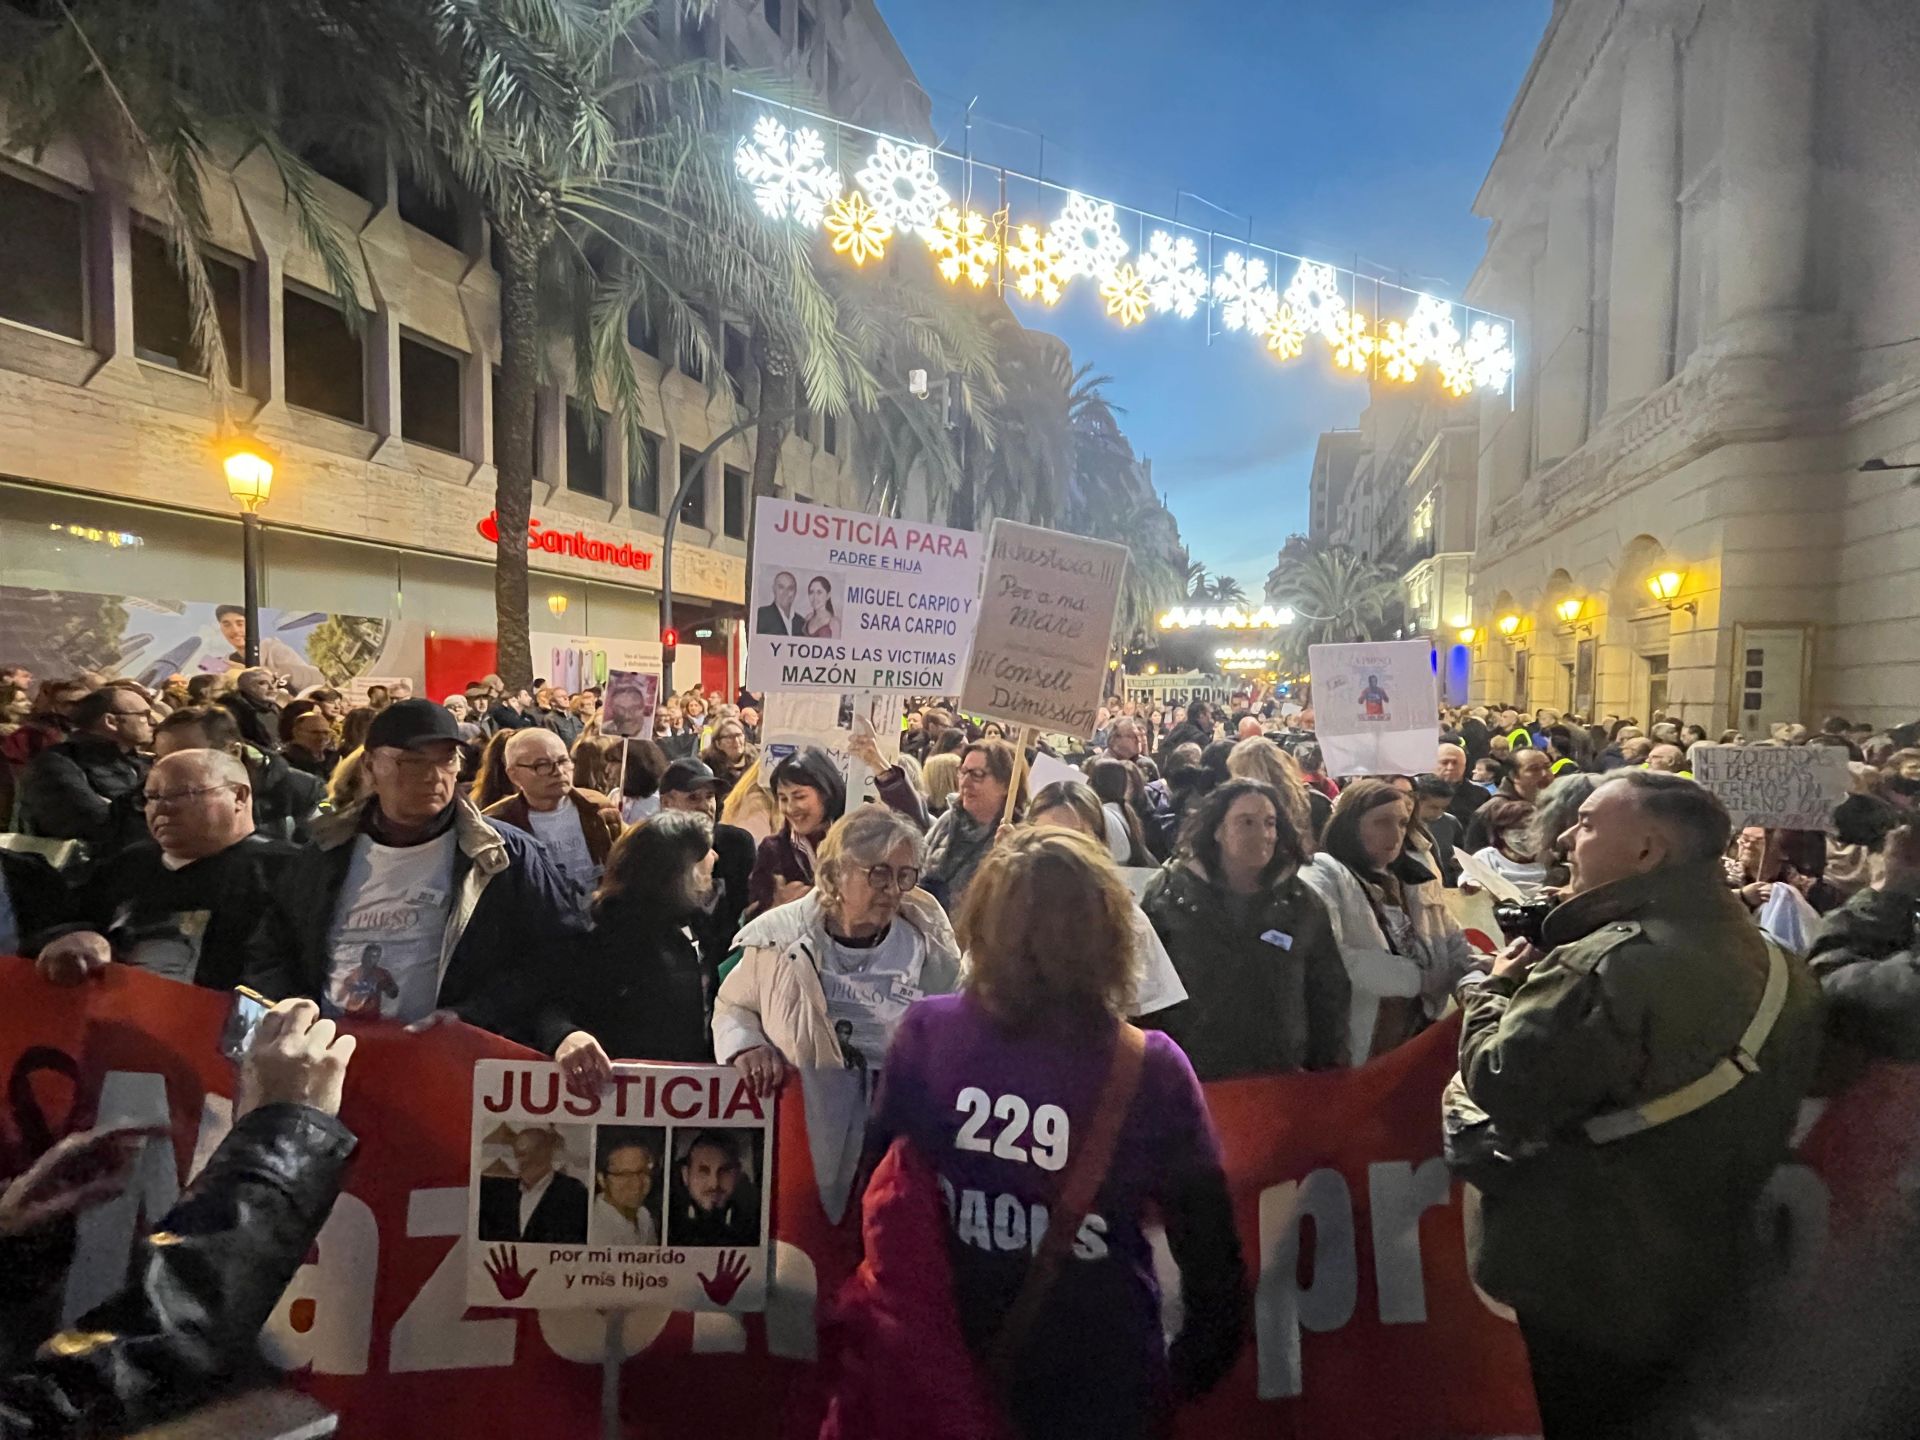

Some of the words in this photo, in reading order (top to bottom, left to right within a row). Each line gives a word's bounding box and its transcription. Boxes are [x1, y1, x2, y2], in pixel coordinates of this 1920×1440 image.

[527, 518, 653, 571] Santander
[774, 508, 898, 551] JUSTICIA
[906, 529, 968, 559] PARA
[829, 549, 878, 569] PADRE
[880, 556, 889, 570] E
[892, 557, 922, 573] HIJA
[847, 586, 904, 609] MIGUEL
[908, 592, 960, 613] CARPIO
[962, 598, 972, 614] Y
[860, 612, 900, 632] SARA
[904, 616, 957, 636] CARPIO
[770, 642, 782, 658] Y
[787, 643, 847, 660] TODAS
[852, 646, 883, 663] LAS
[888, 648, 957, 666] VICTIMAS
[782, 663, 856, 684] MAZÓN
[873, 667, 943, 687] PRISIÓN
[1699, 765, 1719, 782] NI
[483, 1070, 765, 1121] JUSTICIA
[954, 1086, 1070, 1172] 229
[549, 1249, 582, 1266] por
[588, 1249, 611, 1264] mi
[618, 1248, 686, 1265] marido
[565, 1273, 576, 1289] y
[581, 1271, 617, 1288] mis
[622, 1271, 669, 1291] hijos
